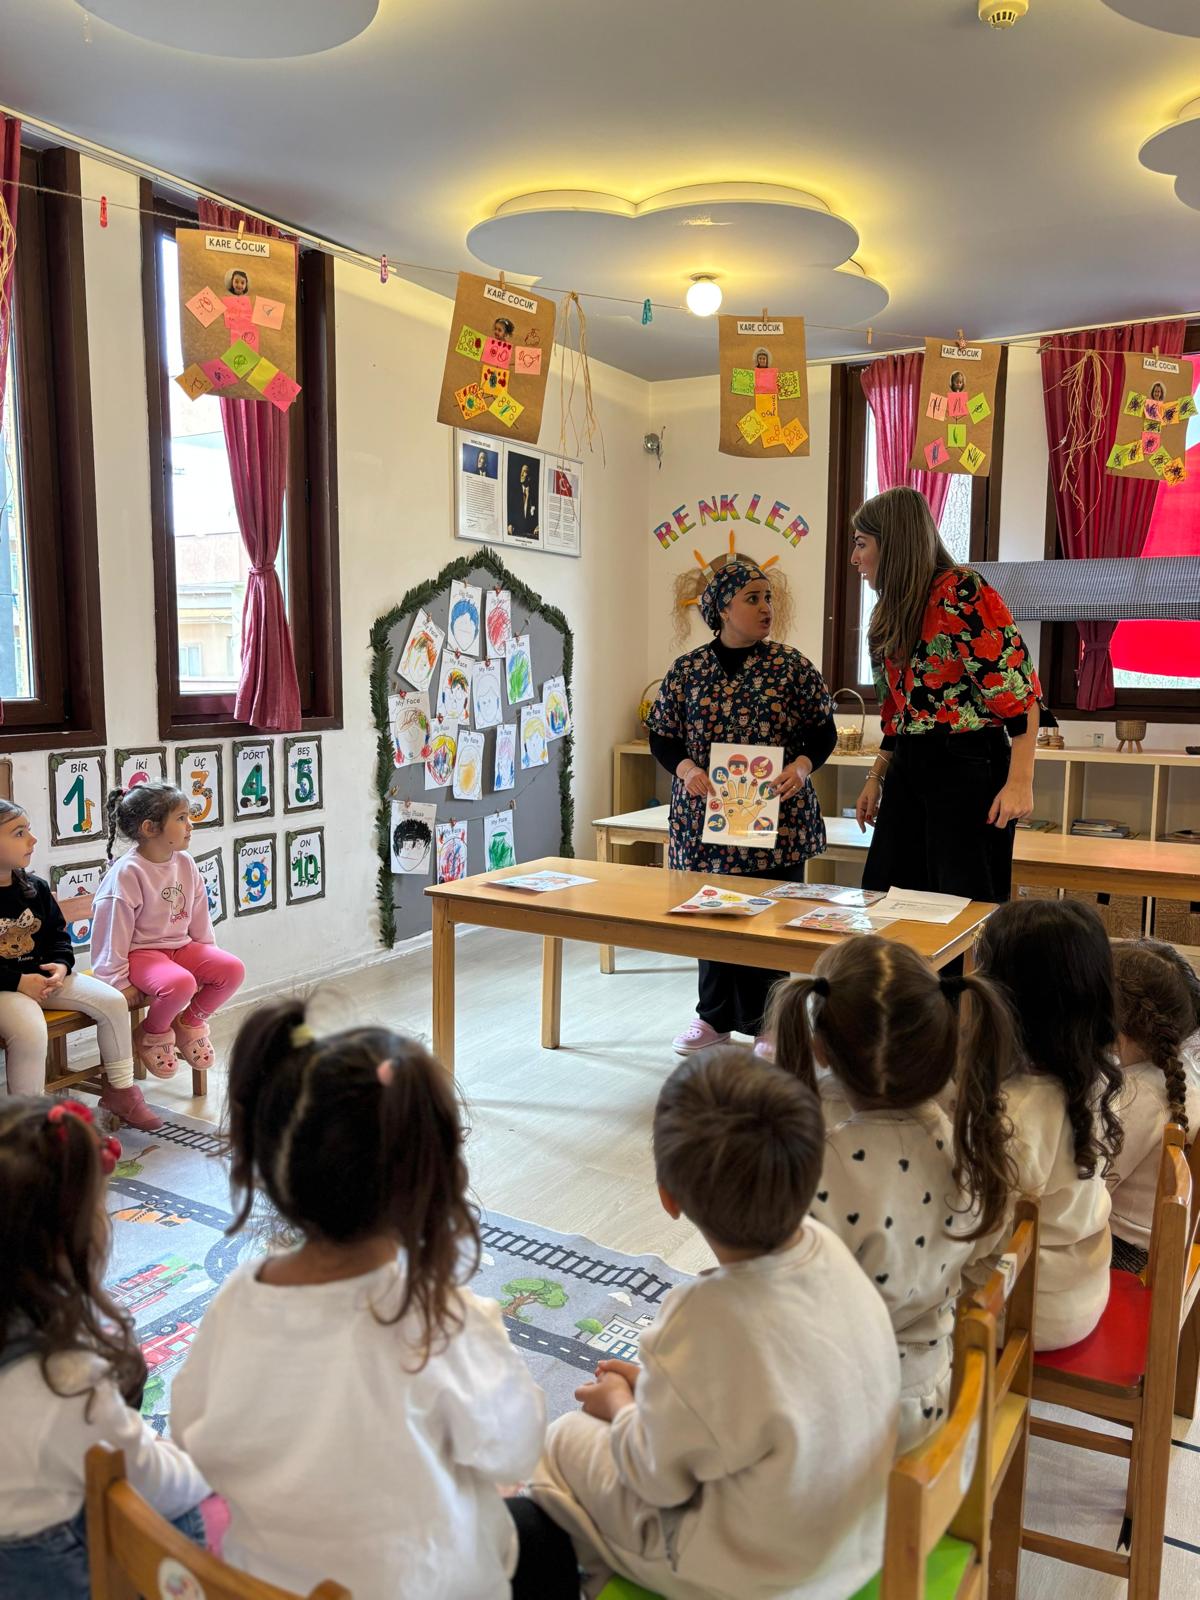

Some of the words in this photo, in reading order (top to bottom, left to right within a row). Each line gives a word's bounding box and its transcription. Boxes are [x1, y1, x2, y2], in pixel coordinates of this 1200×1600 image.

[209, 238, 231, 249] KARE
[487, 287, 506, 301] KARE
[740, 323, 755, 332] KARE
[653, 493, 810, 550] RENKLER
[406, 697, 421, 705] Face
[242, 749, 266, 761] DÖRT
[297, 746, 311, 757] BEŞ
[70, 760, 88, 774] BİR
[193, 756, 207, 769] ÜÇ
[241, 763, 267, 803] 4
[295, 757, 315, 803] 5
[186, 769, 210, 823] 3
[62, 773, 86, 833] 1
[299, 838, 311, 848] ON
[240, 845, 270, 857] DOKUZ
[198, 861, 214, 874] KİZ
[291, 853, 320, 887] 10
[68, 872, 93, 885] ALTI
[244, 861, 268, 903] 9
